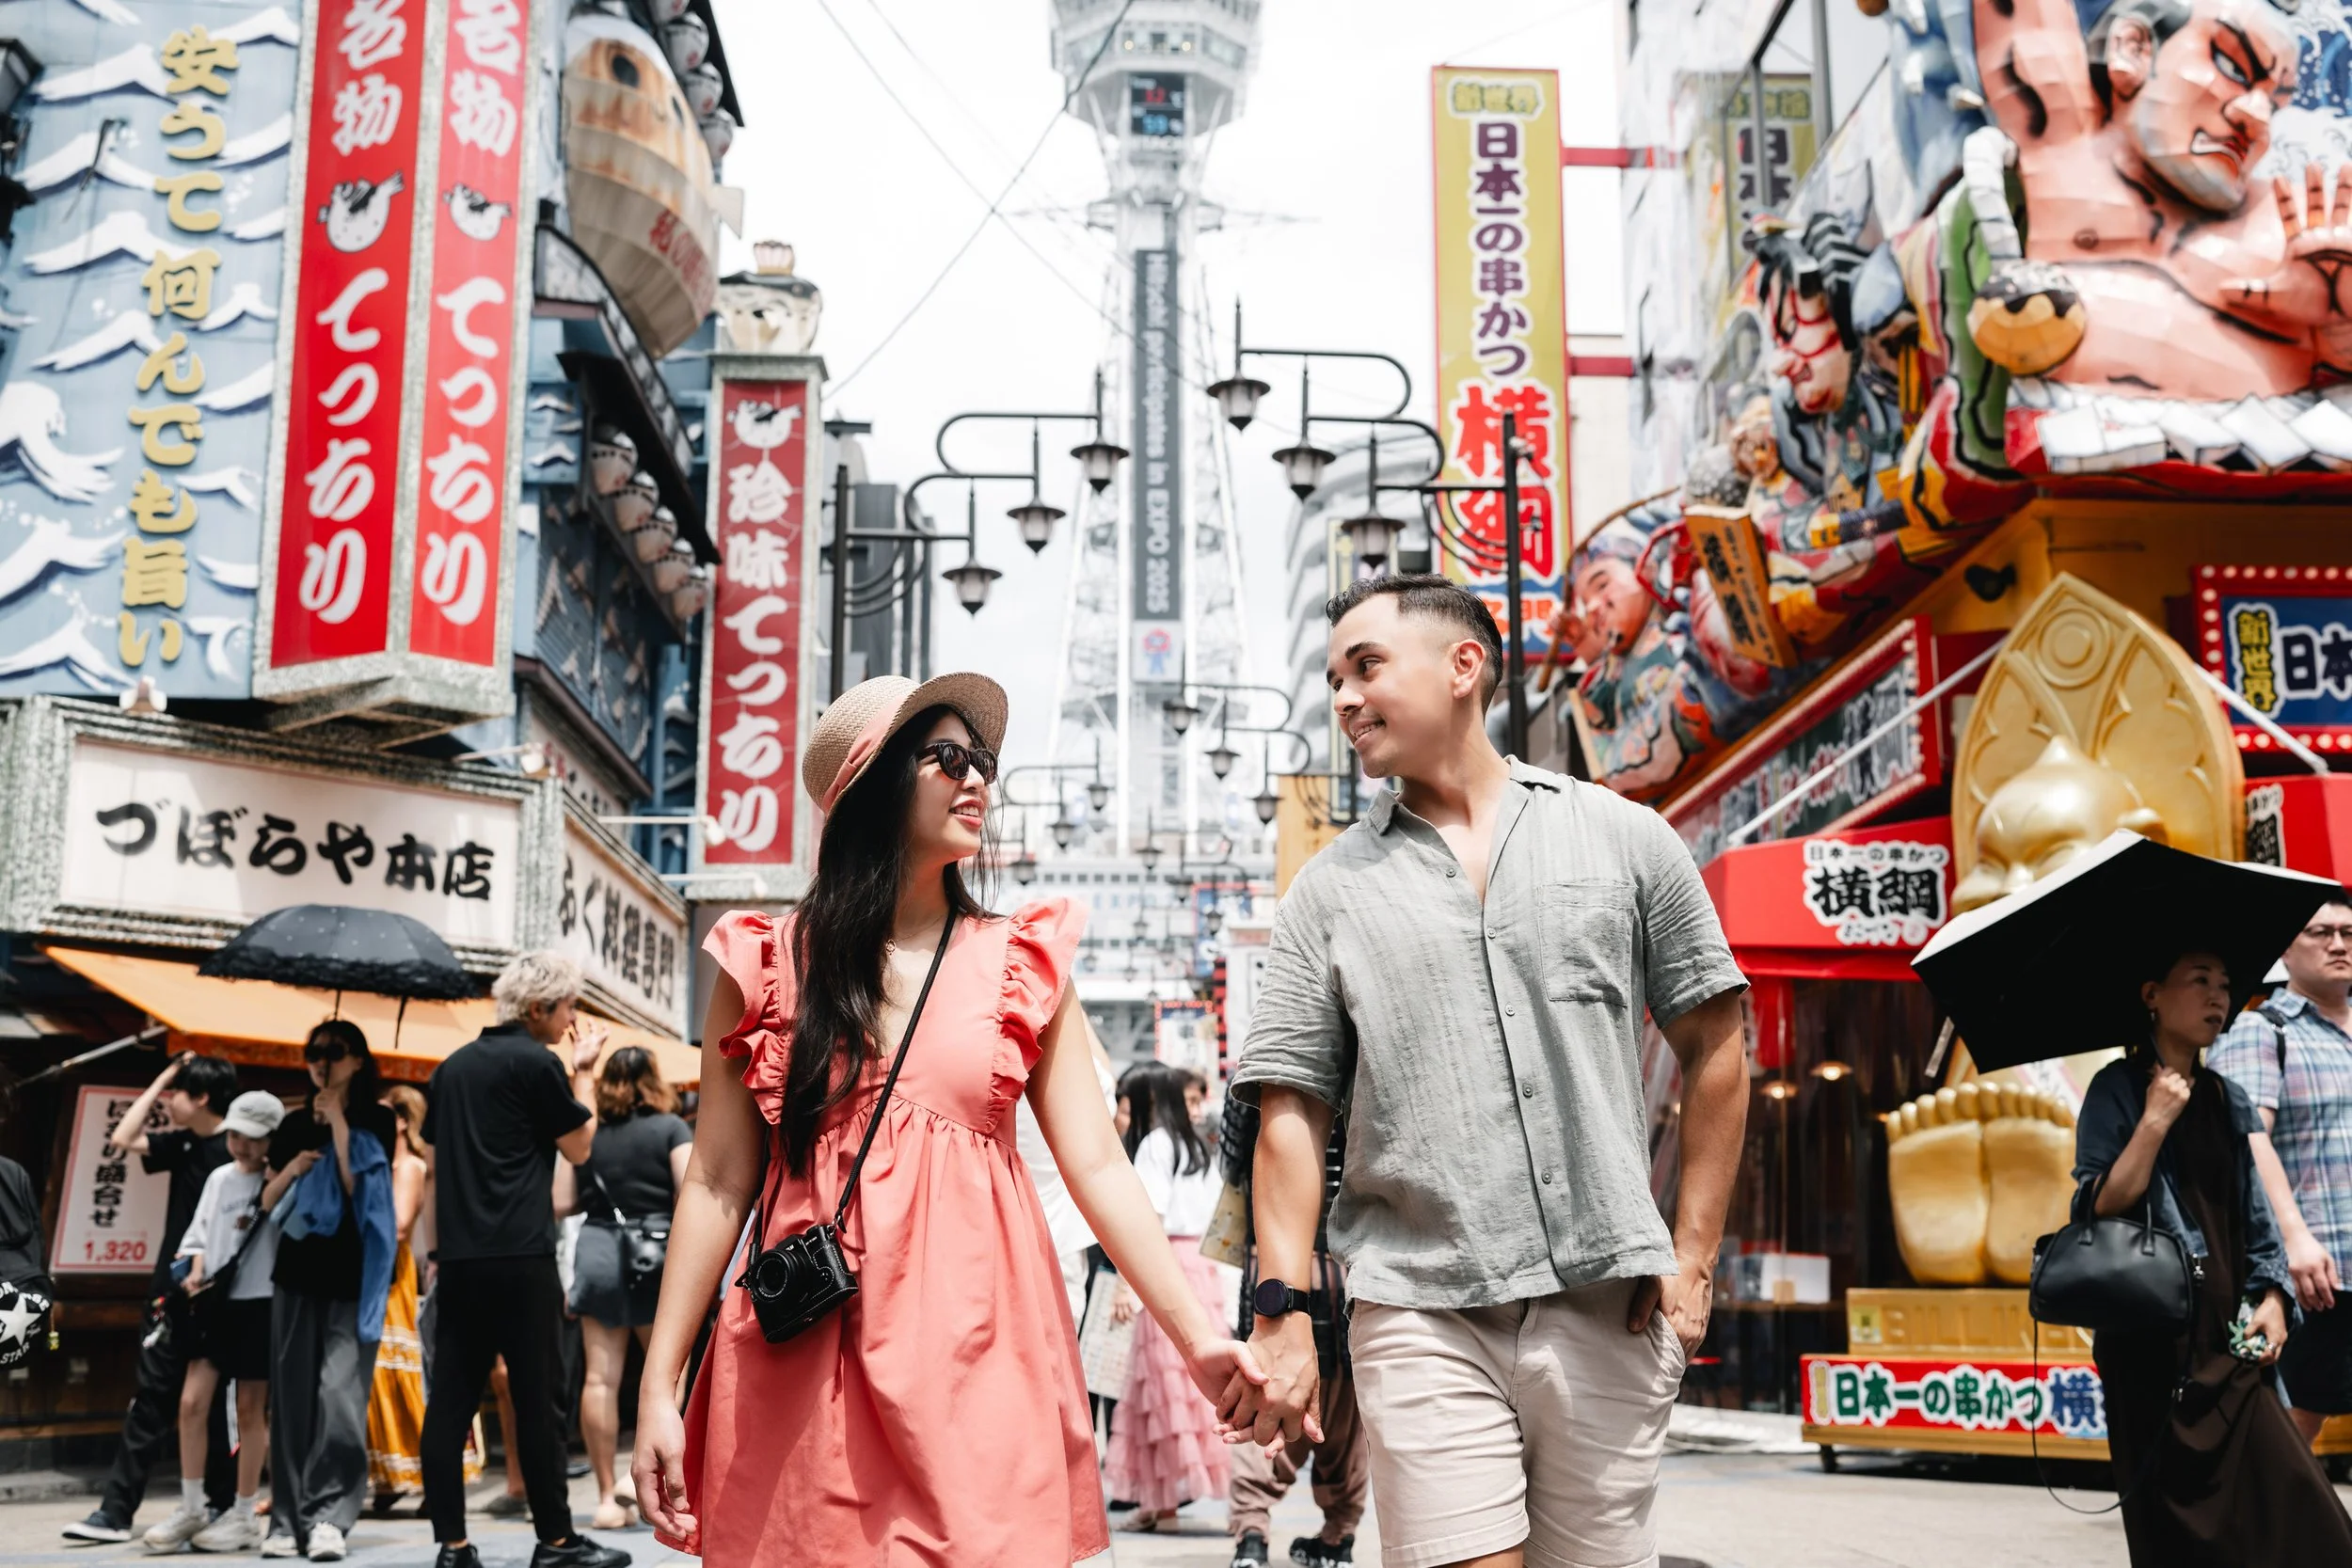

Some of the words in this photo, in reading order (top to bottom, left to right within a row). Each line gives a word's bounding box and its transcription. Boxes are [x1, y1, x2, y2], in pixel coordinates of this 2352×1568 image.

[1475, 122, 1528, 376] 日本一の串かつ
[299, 267, 389, 624] てっちり
[421, 277, 505, 626] てっちり
[1146, 488, 1169, 555] EXPO
[1146, 558, 1169, 613] 2025
[96, 798, 494, 900] づぼらや本店
[1812, 866, 1939, 920] 横綱
